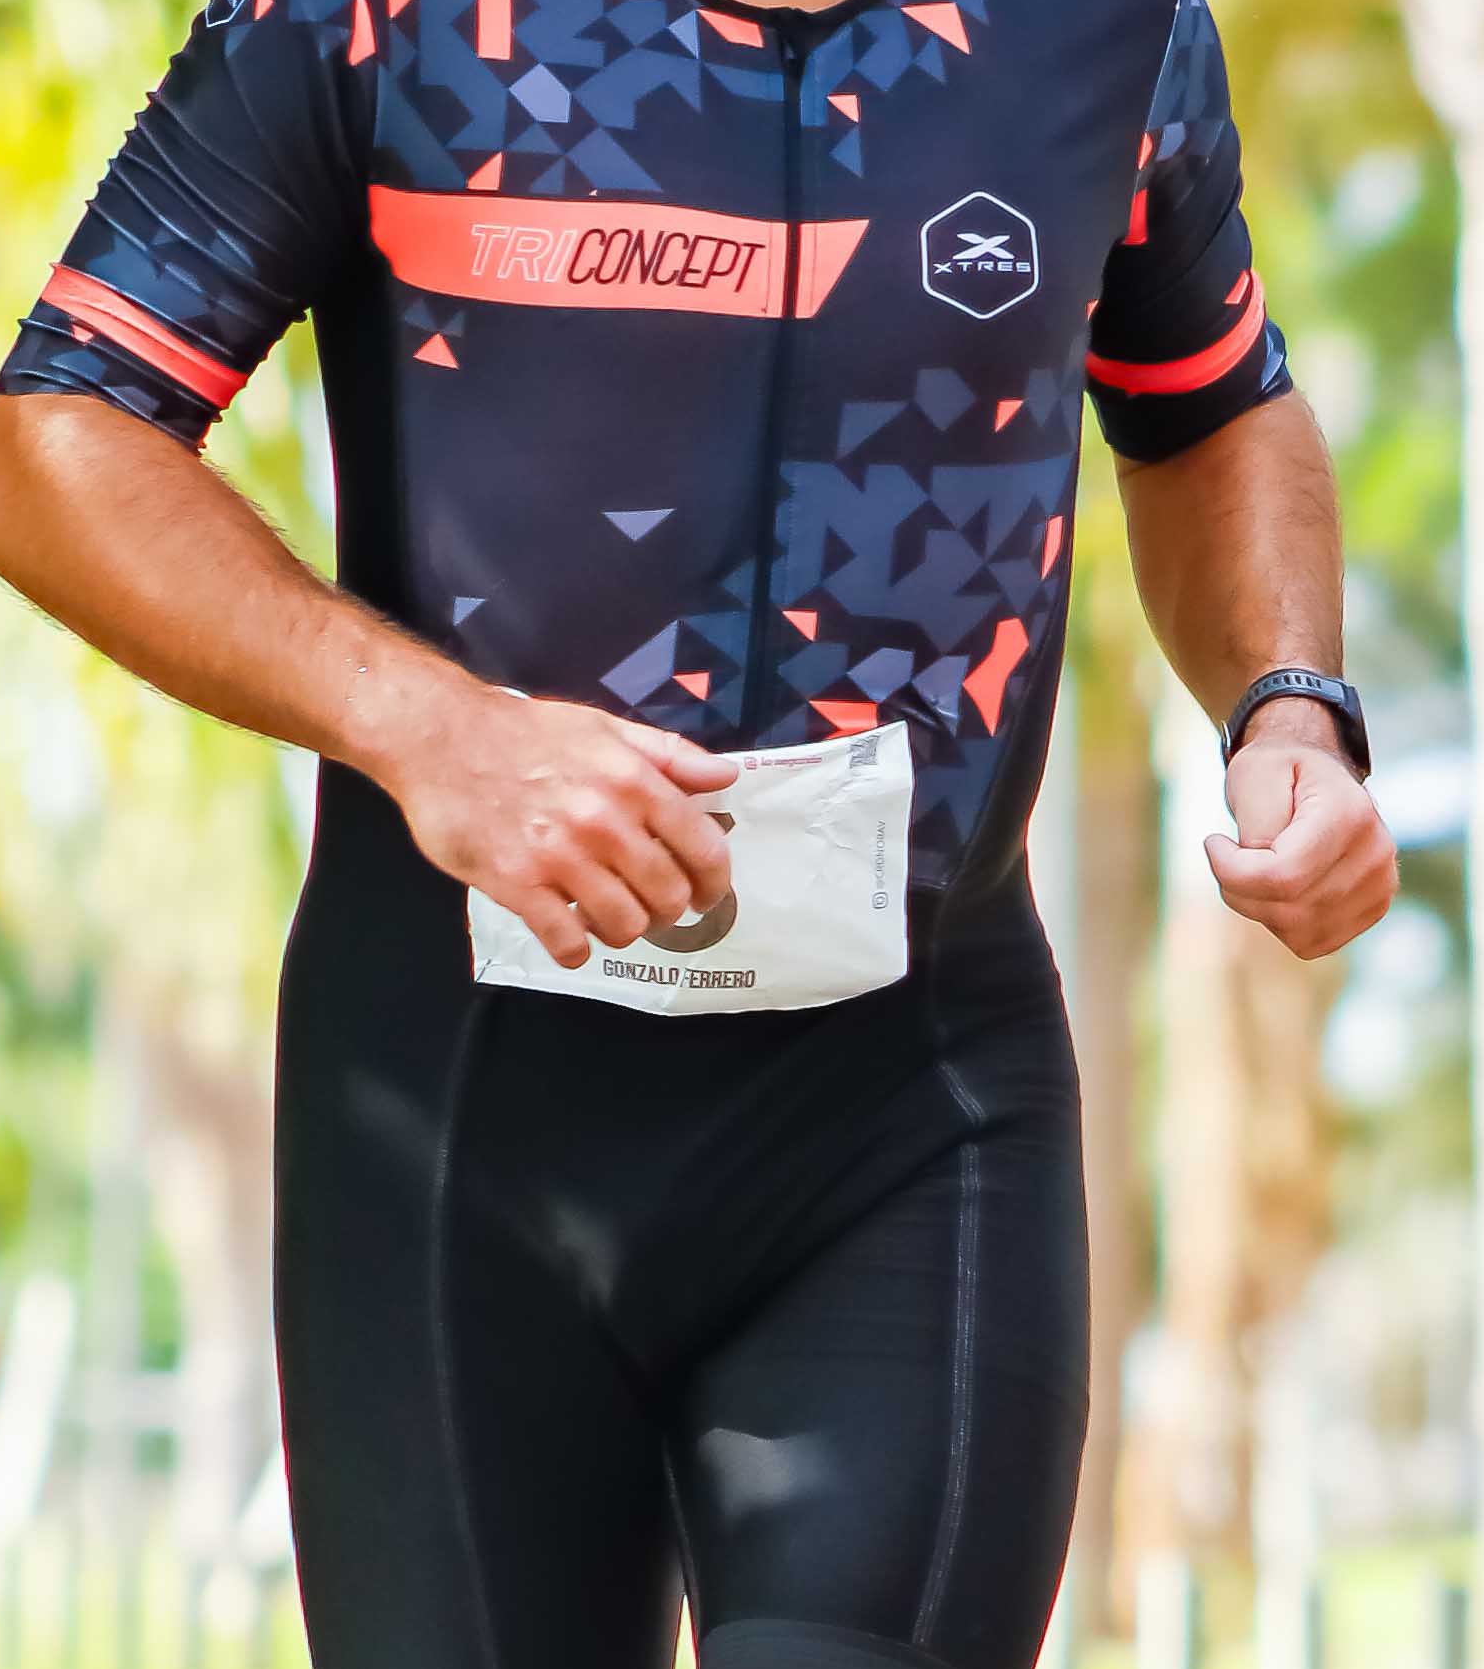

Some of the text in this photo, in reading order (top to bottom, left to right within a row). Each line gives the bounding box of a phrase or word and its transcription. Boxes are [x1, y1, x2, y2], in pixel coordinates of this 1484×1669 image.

[933, 261, 1031, 274] XTRES
[603, 958, 757, 989] GONZALO FERRERO
